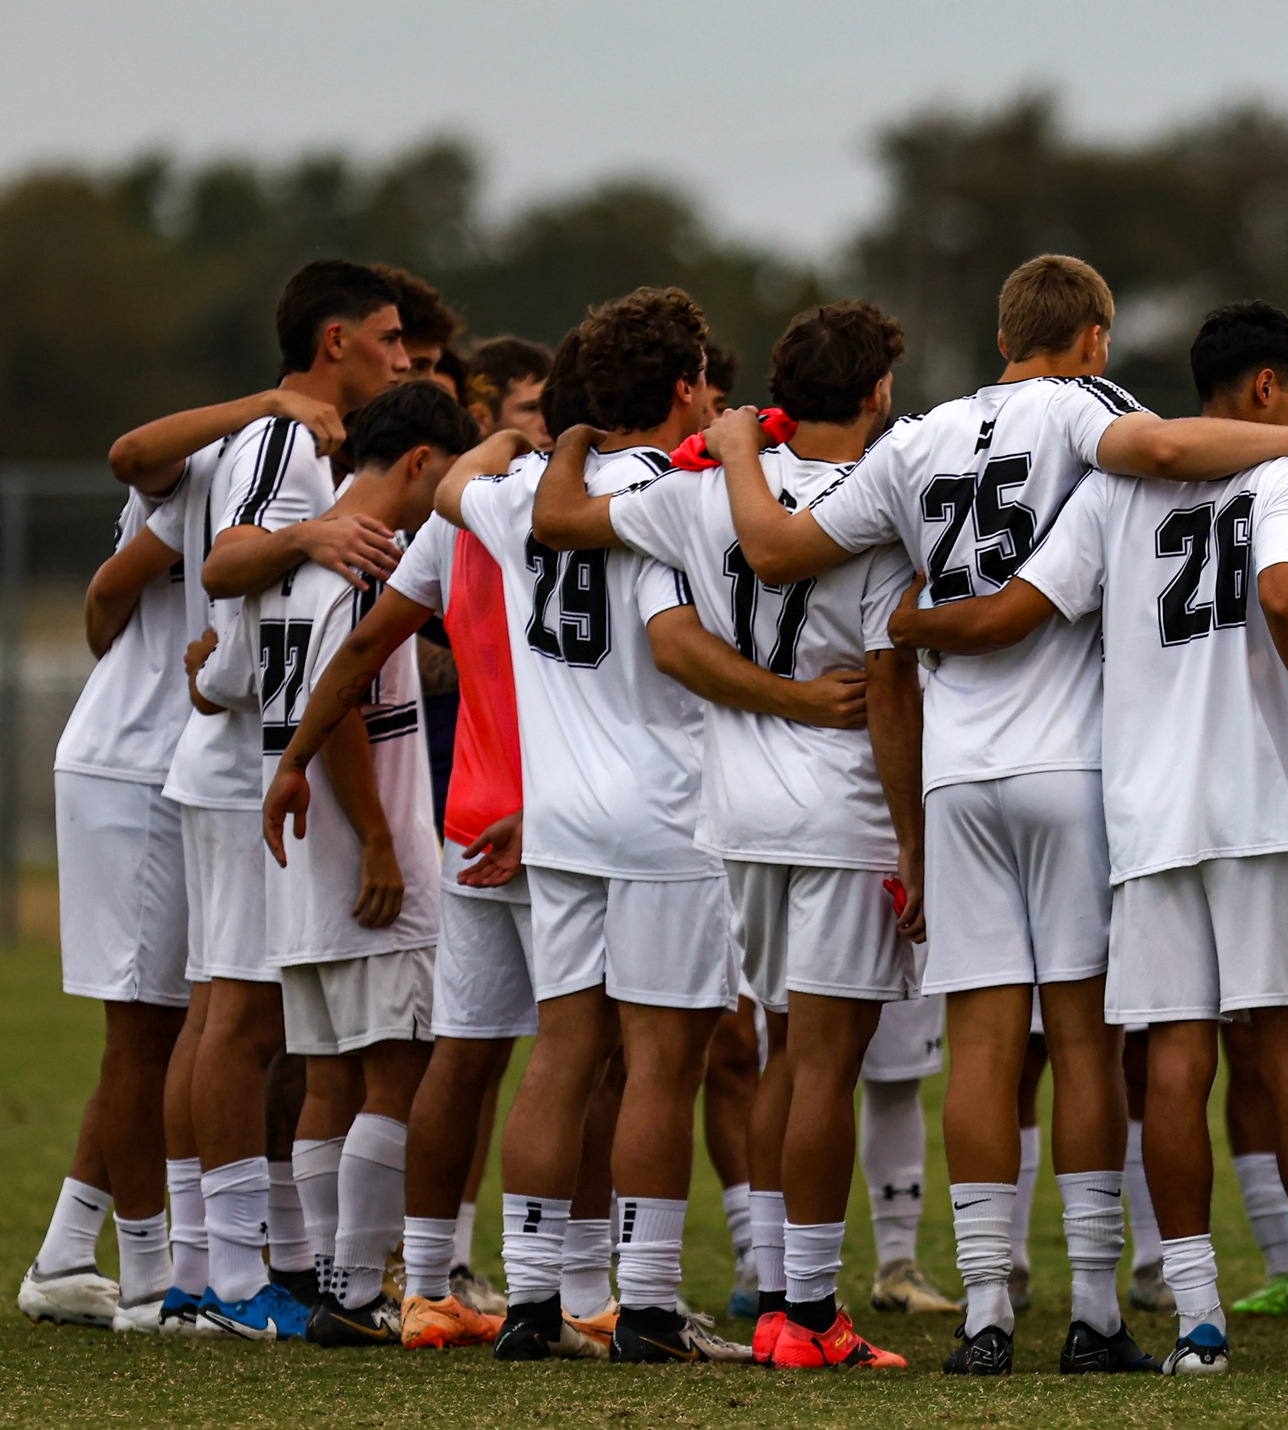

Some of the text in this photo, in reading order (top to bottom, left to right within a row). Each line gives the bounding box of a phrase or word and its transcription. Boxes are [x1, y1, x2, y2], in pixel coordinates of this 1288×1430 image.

[524, 527, 611, 669] 29
[920, 451, 1037, 606] 25
[1155, 490, 1257, 647] 26
[722, 540, 817, 679] 17
